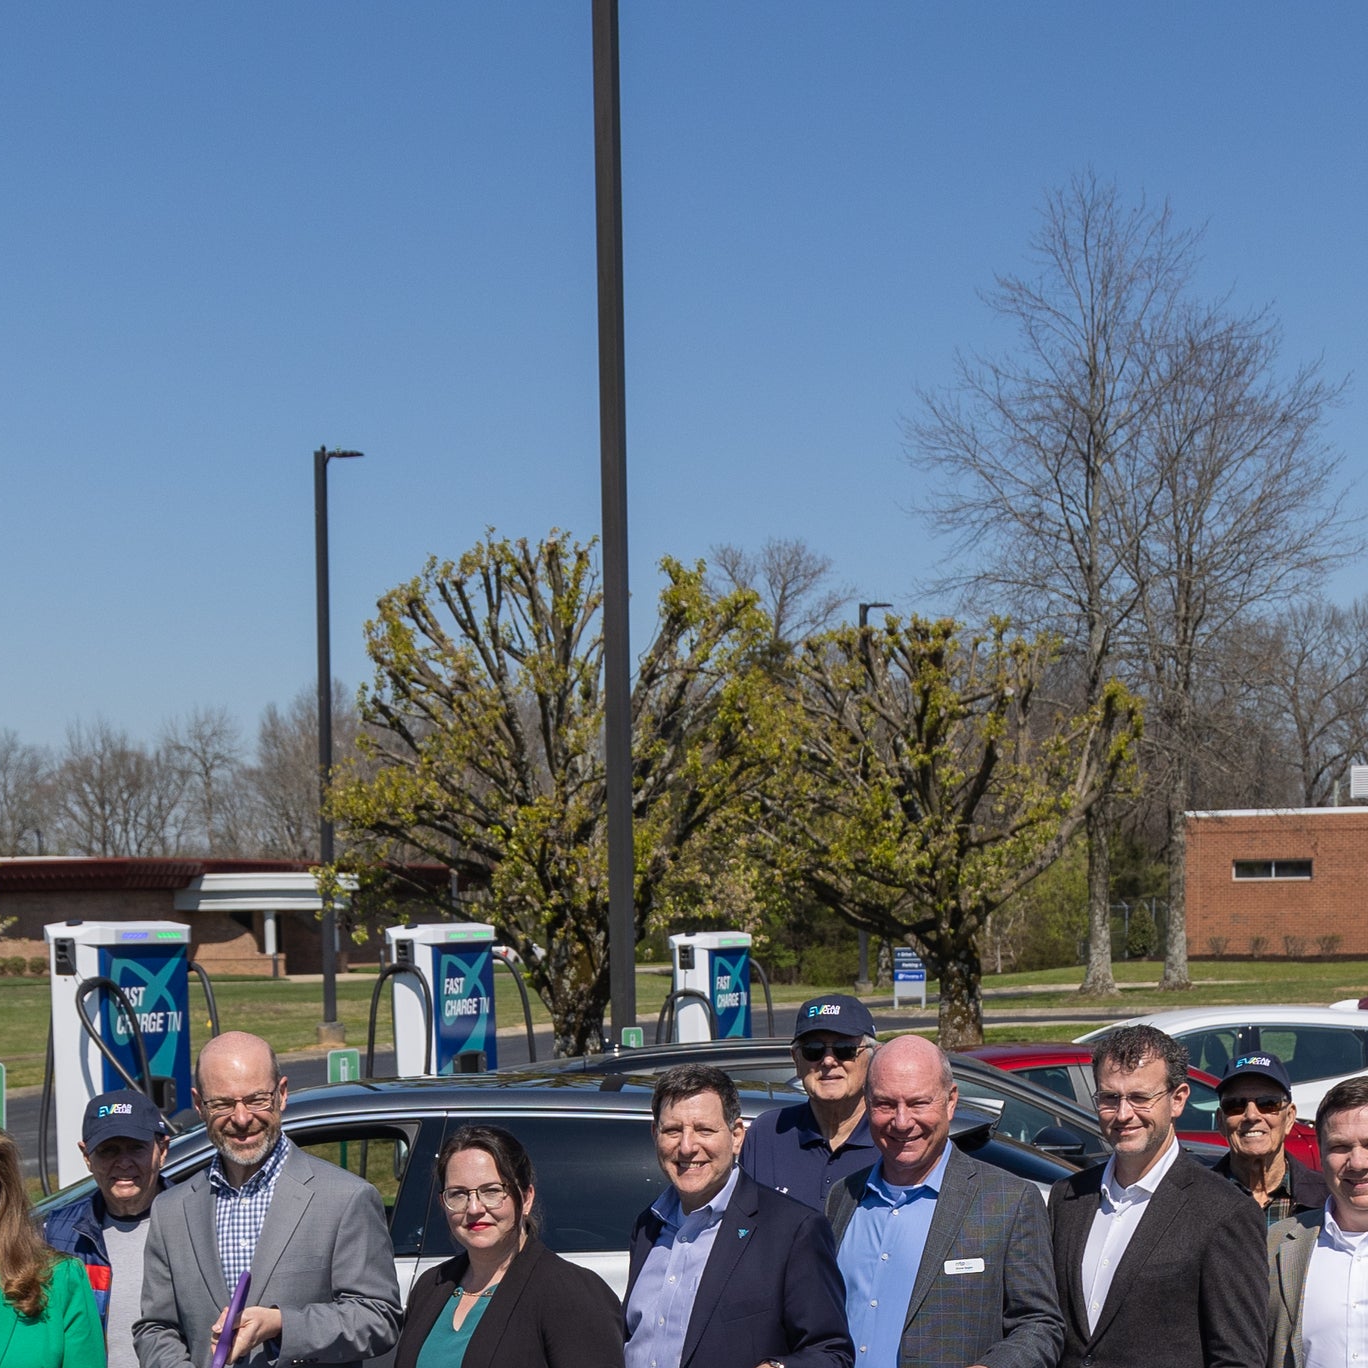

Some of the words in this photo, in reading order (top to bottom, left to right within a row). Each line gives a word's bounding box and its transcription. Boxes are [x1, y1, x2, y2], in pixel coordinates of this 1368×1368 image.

[444, 976, 466, 995] FAST
[716, 975, 731, 990] FAST
[116, 986, 146, 1007] ST
[717, 992, 739, 1008] CHARGE
[740, 992, 748, 1006] TN
[444, 998, 478, 1017] CHARGE
[479, 997, 490, 1014] TN
[166, 1011, 182, 1032] TN
